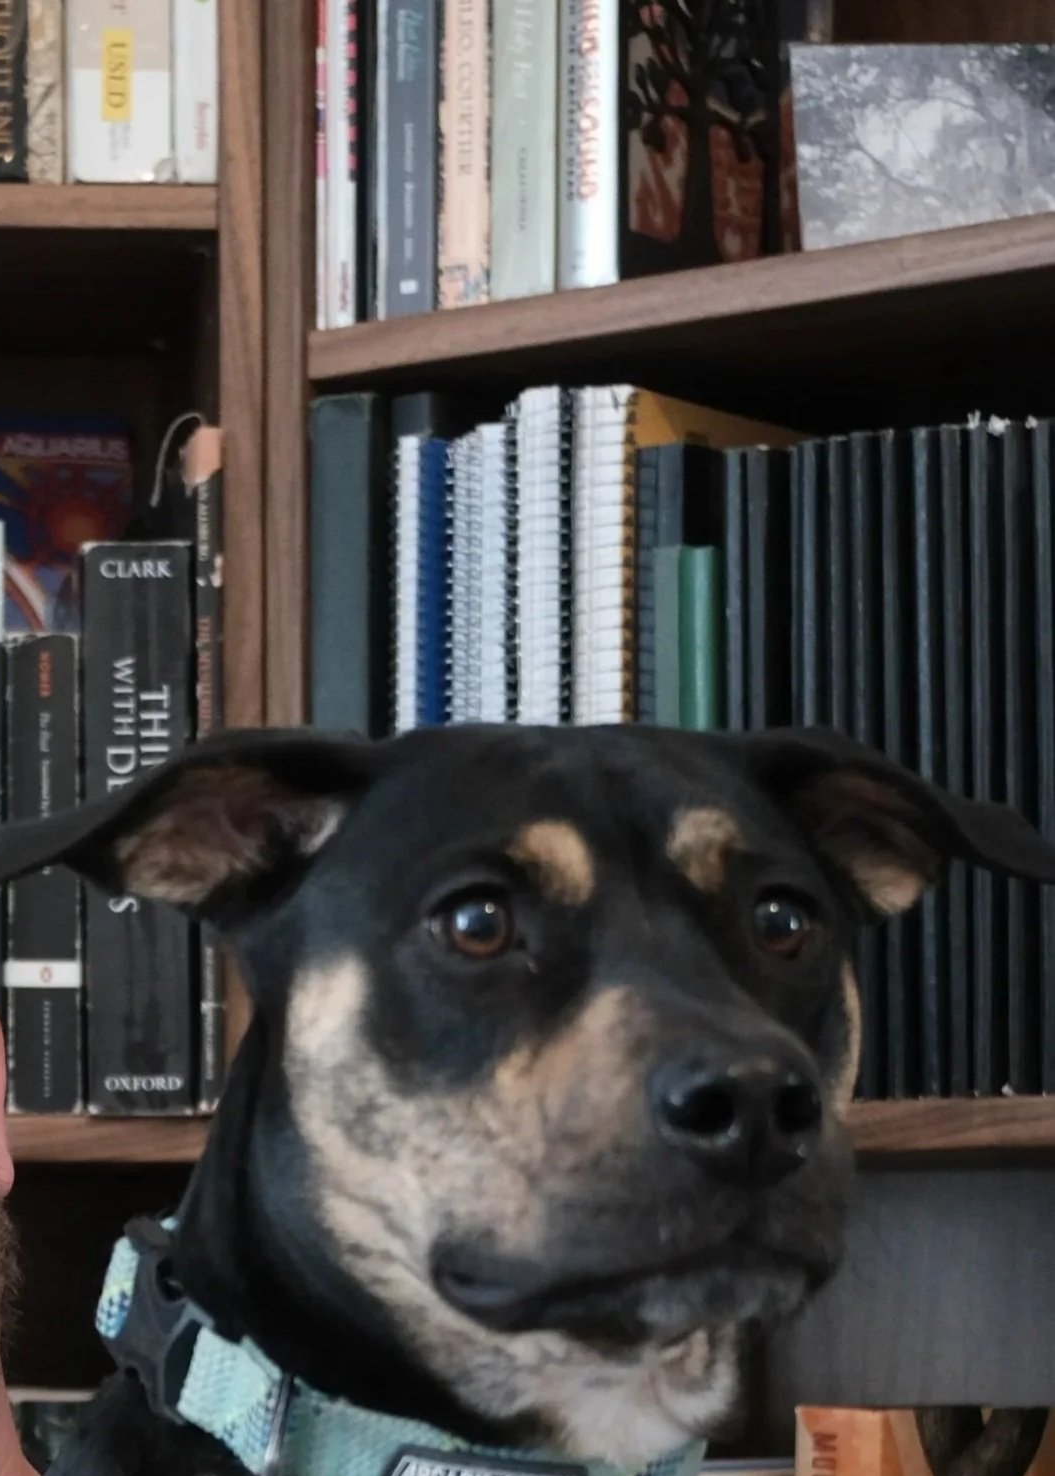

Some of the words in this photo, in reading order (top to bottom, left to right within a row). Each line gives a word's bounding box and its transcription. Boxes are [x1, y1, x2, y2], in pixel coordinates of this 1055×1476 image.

[105, 42, 128, 109] USED
[3, 435, 128, 460] AQUARIUS
[99, 559, 173, 579] CLARK
[111, 656, 137, 737] WITH
[104, 1075, 184, 1091] OXFORD
